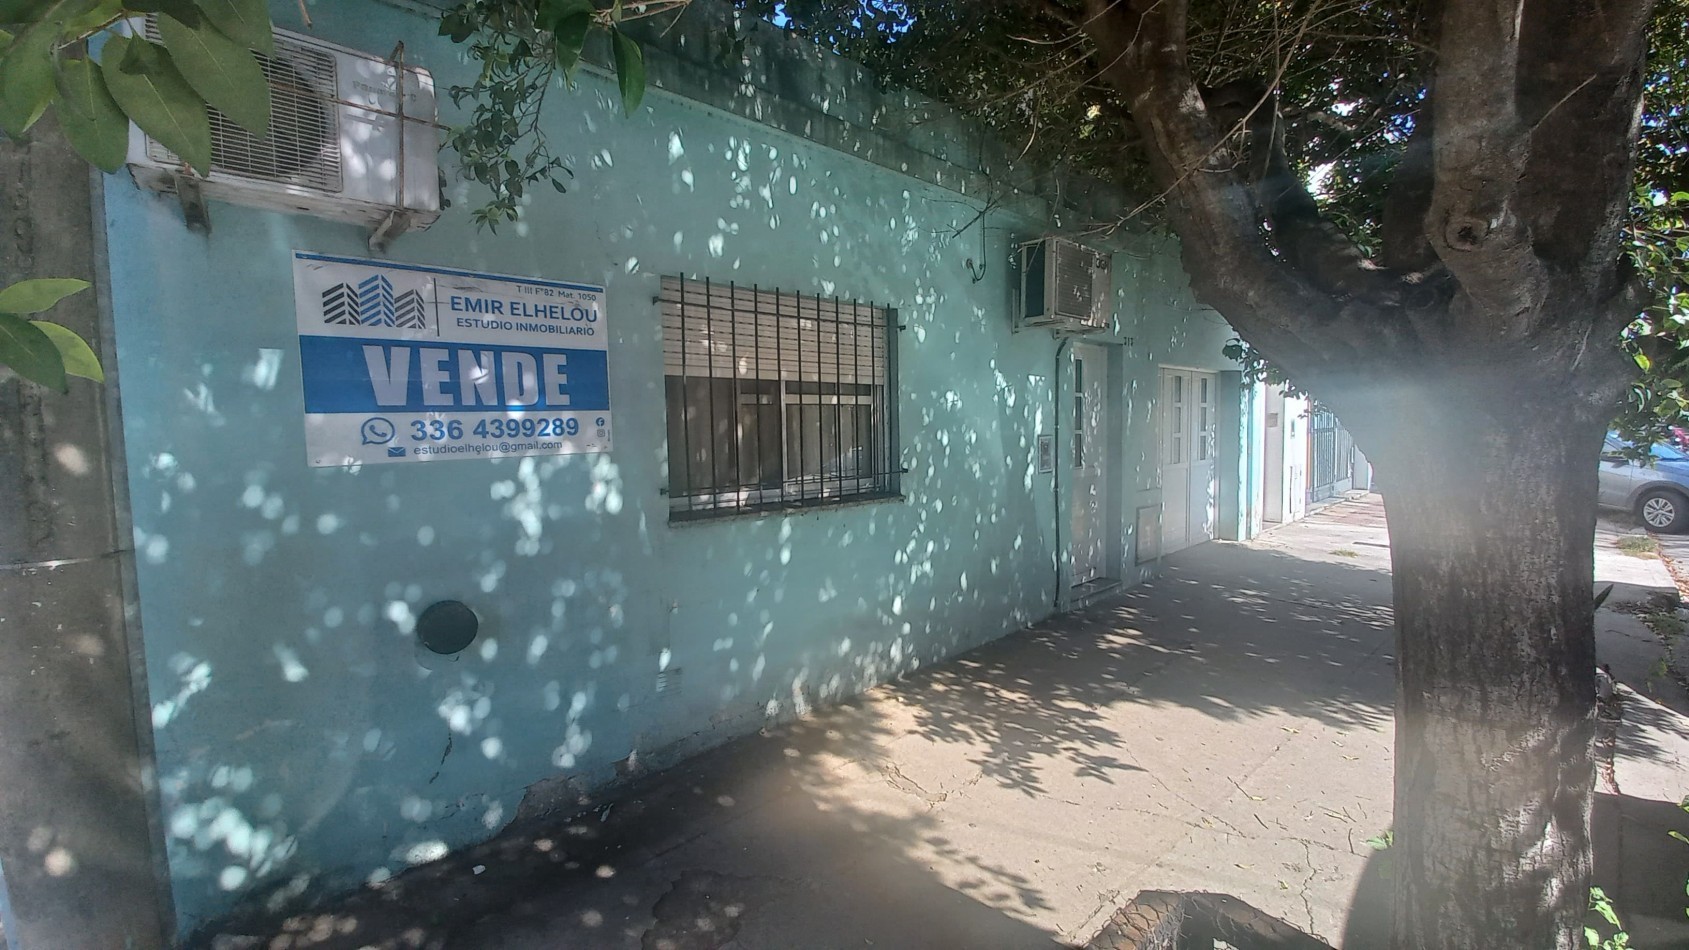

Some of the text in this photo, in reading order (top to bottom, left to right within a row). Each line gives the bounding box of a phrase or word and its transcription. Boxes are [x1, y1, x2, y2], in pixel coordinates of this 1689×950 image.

[516, 284, 522, 294] T
[558, 290, 575, 299] Mat.
[578, 293, 597, 302] 1050
[450, 295, 598, 323] EMIR ELHELOU
[456, 317, 595, 337] ESTUDIO INMOBILIARIO
[362, 344, 571, 406] VENDE
[410, 417, 579, 441] 336 4399289
[413, 441, 563, 455] estudioelhelou@gmail.com
